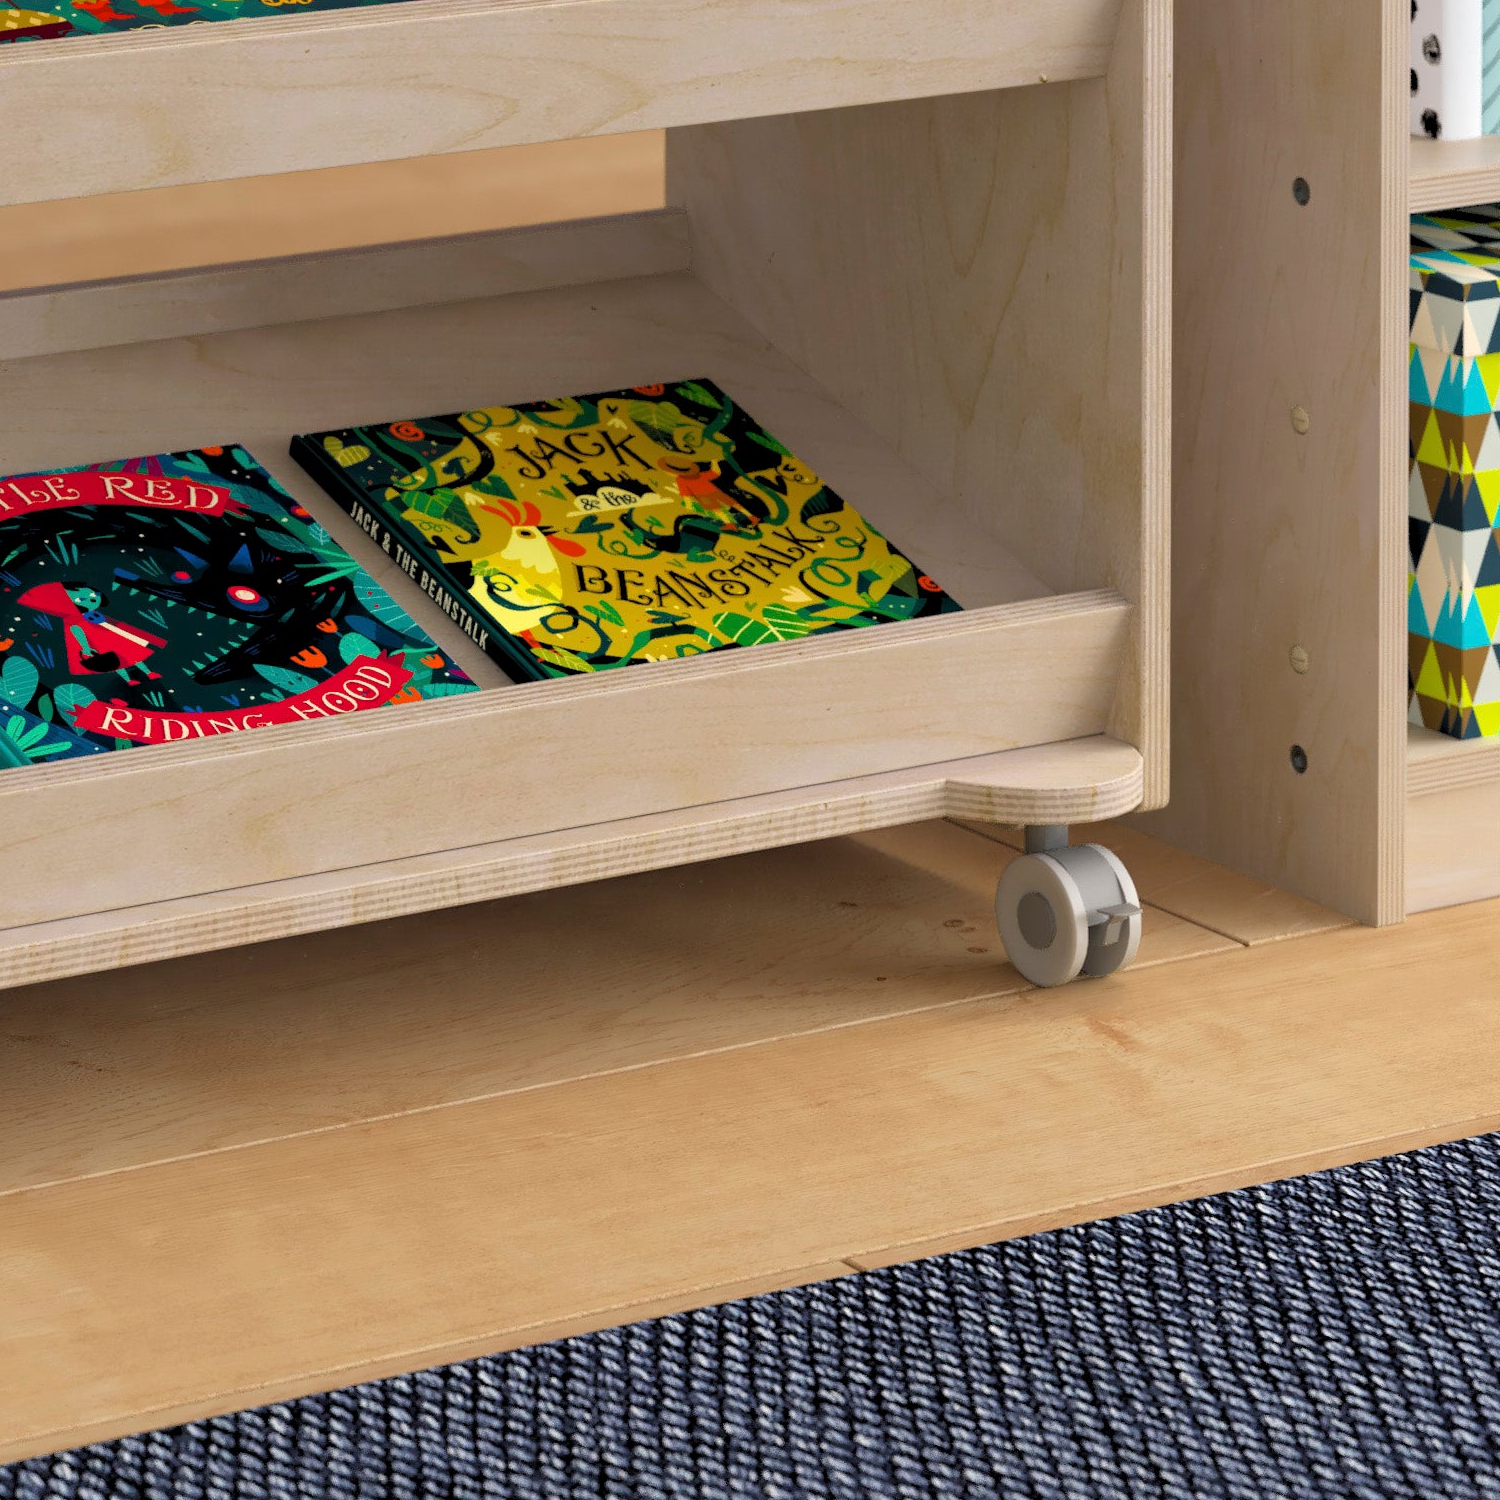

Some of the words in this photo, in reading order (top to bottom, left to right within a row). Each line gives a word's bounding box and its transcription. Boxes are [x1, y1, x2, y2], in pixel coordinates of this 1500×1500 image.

[506, 430, 656, 479] JACK
[99, 476, 219, 509] RED
[602, 492, 637, 506] the
[350, 501, 380, 541] JACK
[395, 544, 418, 579] THE
[420, 570, 489, 650] BEANSTALK
[573, 526, 825, 609] BEANSTALK
[290, 665, 392, 720] HOOD
